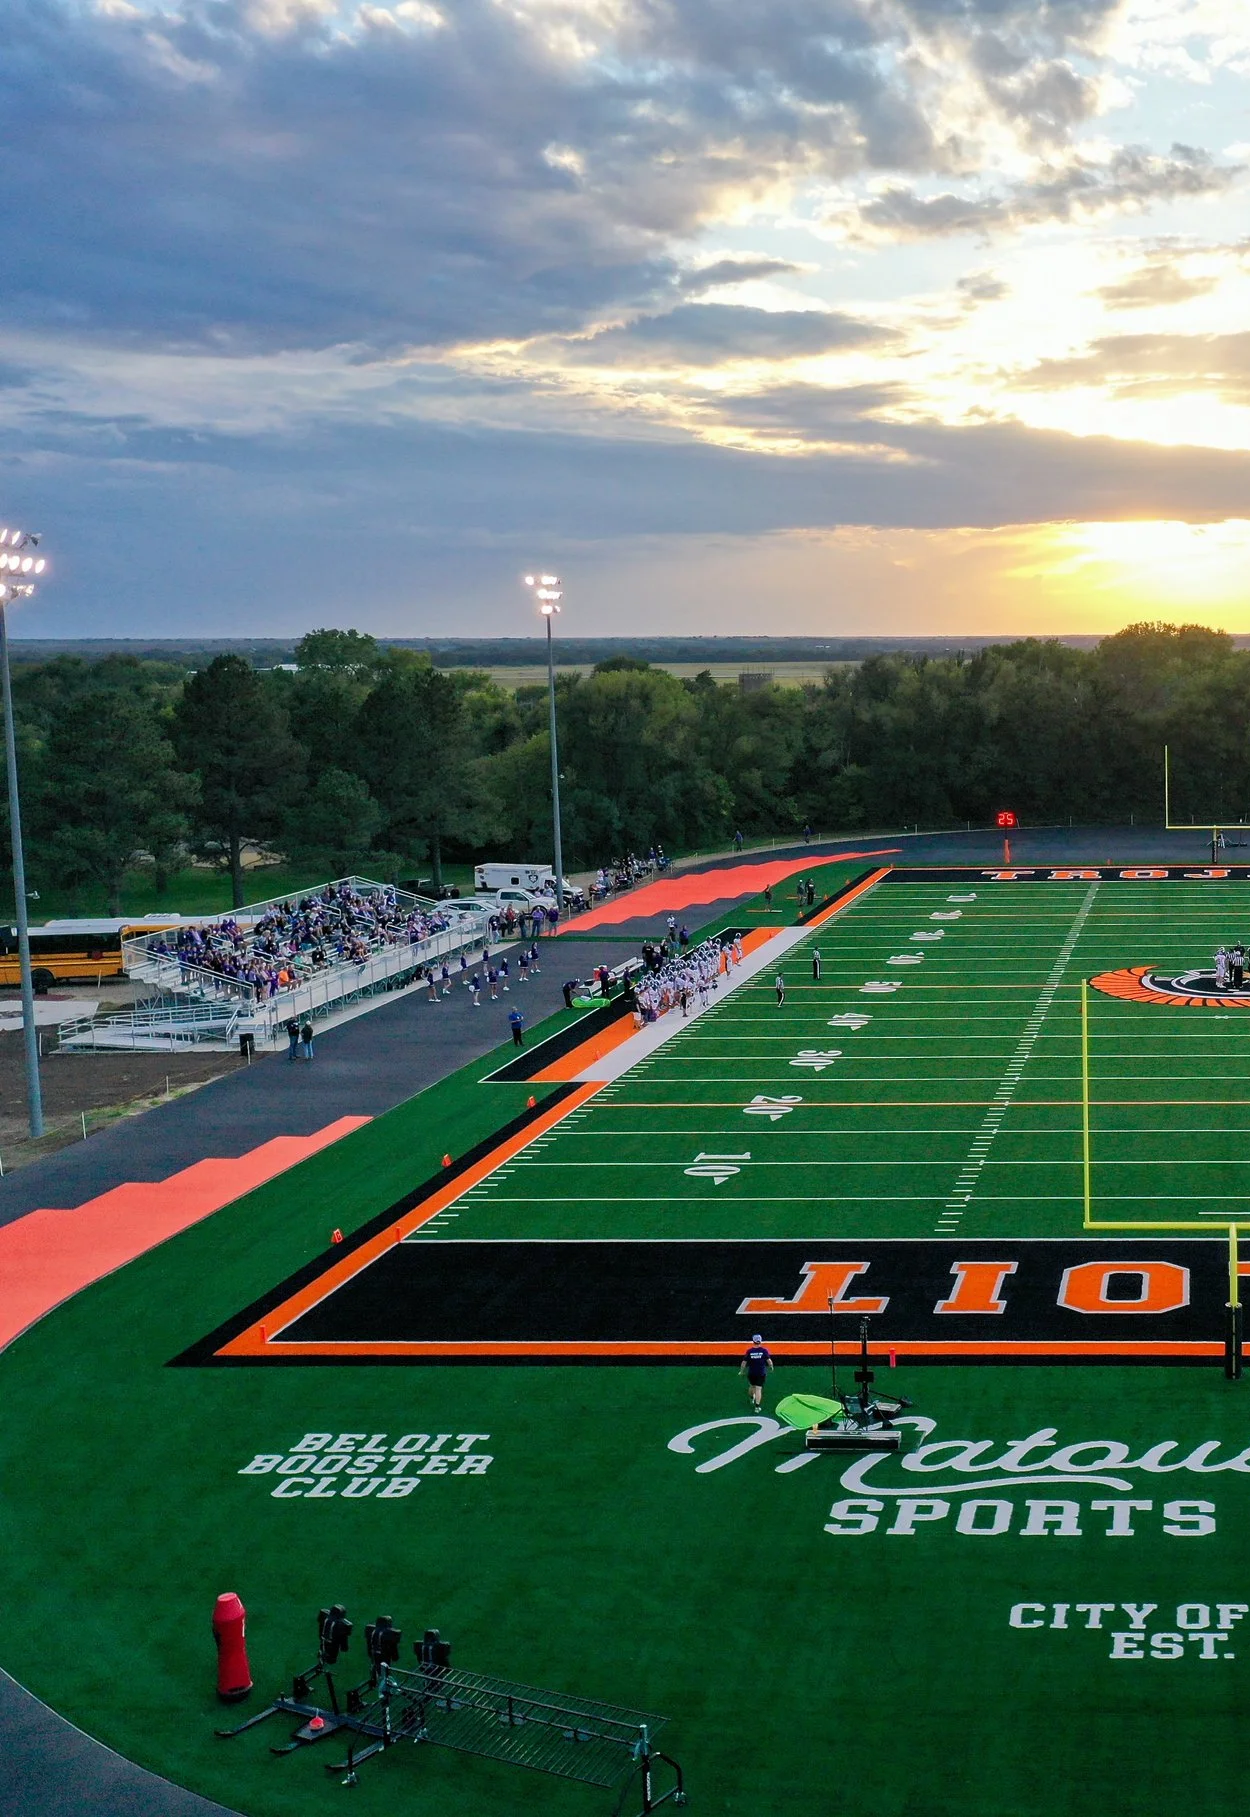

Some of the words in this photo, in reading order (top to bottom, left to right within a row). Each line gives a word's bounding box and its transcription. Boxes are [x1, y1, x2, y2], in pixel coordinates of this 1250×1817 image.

[998, 813, 1014, 825] 25
[683, 1151, 751, 1177] 10
[289, 1433, 490, 1452] BELOIT
[237, 1454, 494, 1475] BOOSTER
[270, 1476, 421, 1498] CLUB
[823, 1499, 1216, 1536] SPORTS
[1009, 1603, 1158, 1629] CITY
[1176, 1603, 1249, 1630] OF
[1109, 1632, 1235, 1659] EST.
